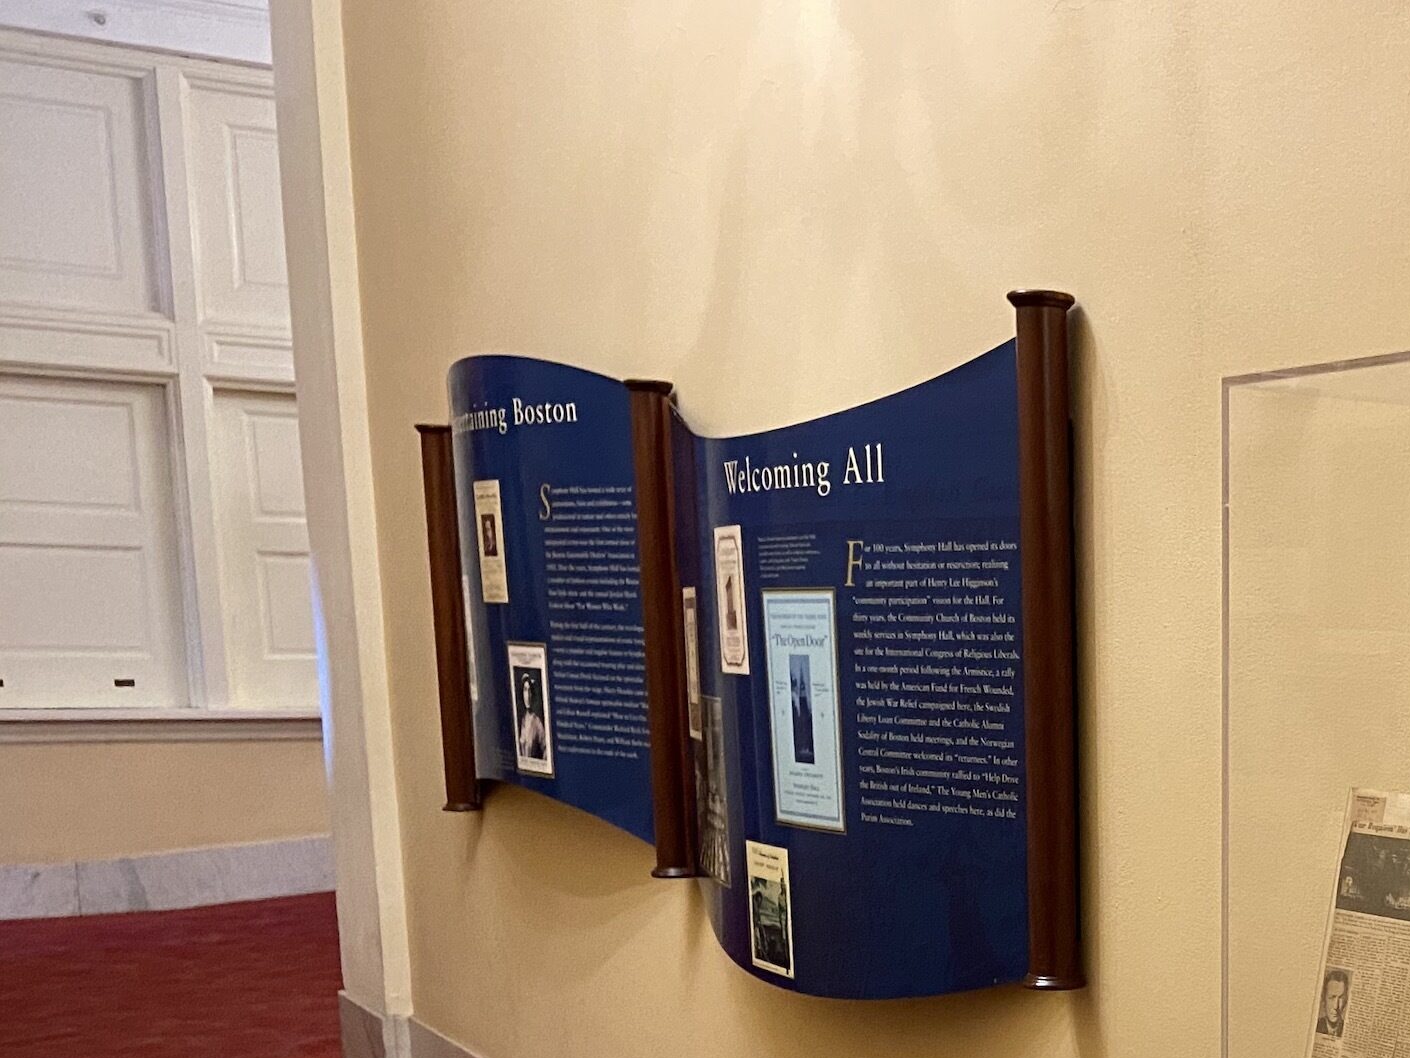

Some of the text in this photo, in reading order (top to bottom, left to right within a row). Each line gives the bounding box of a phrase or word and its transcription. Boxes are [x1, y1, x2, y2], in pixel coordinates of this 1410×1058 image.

[513, 398, 577, 425] Boston
[724, 443, 885, 496] Welcoming All
[787, 636, 805, 648] Open
[805, 634, 828, 648] Door”
